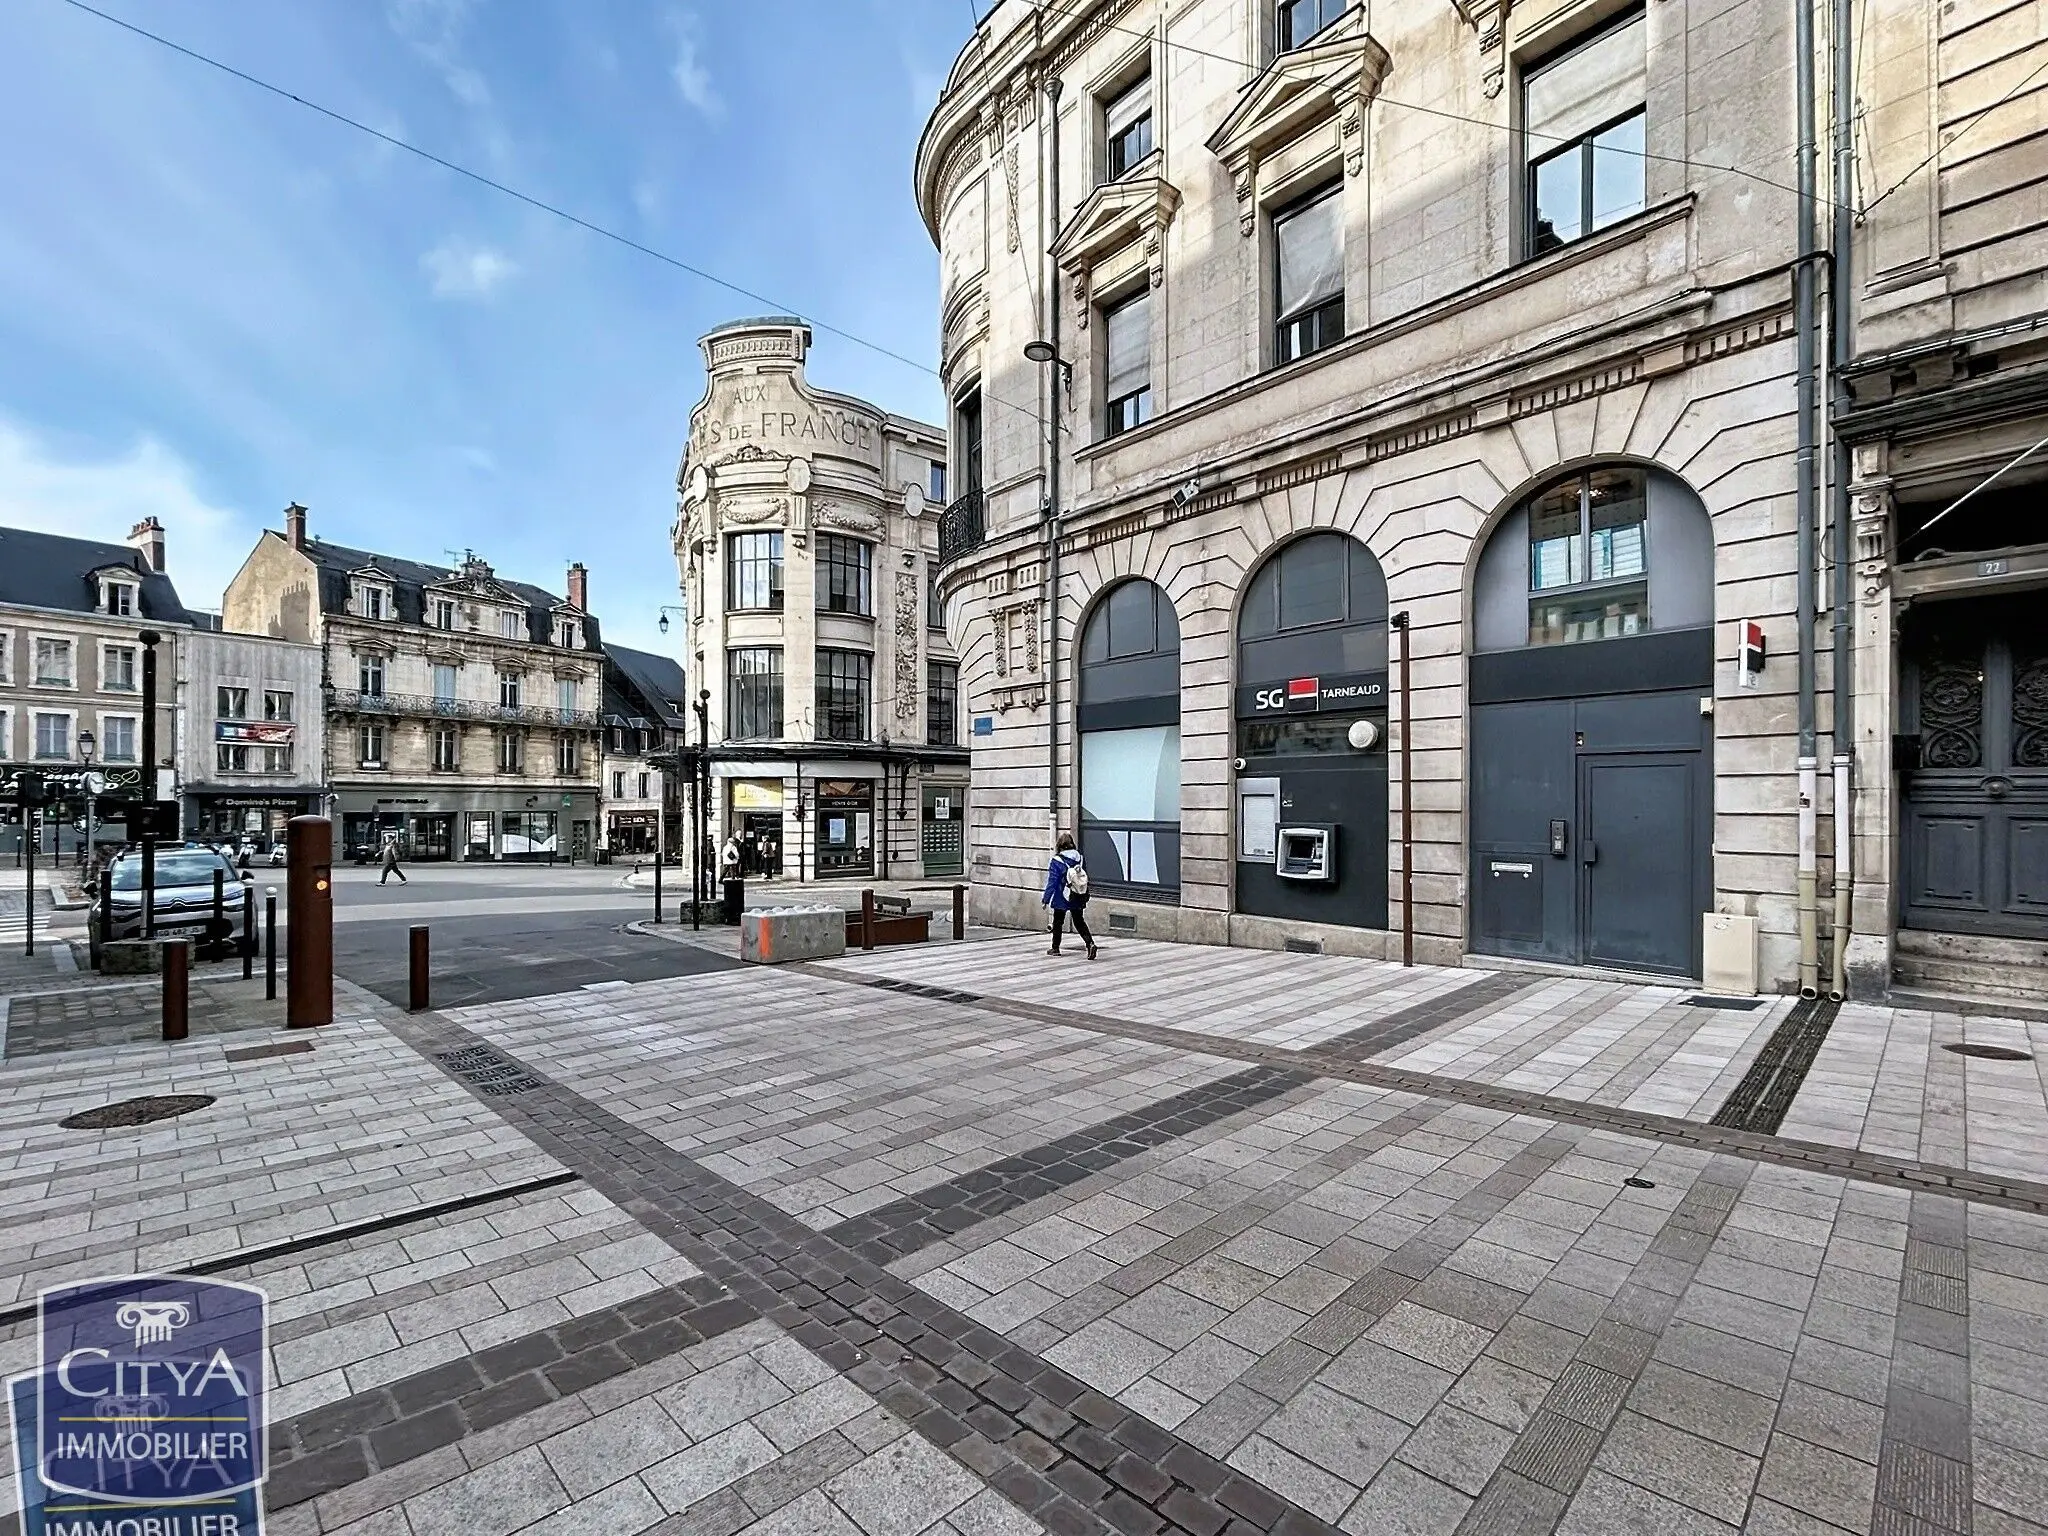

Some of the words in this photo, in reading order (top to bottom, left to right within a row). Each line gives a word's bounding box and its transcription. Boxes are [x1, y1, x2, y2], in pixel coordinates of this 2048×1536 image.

[733, 385, 766, 404] AUX
[728, 424, 752, 441] DE
[761, 412, 872, 451] FRANCE
[1255, 688, 1285, 710] SG
[1321, 684, 1381, 699] TARNEAUD
